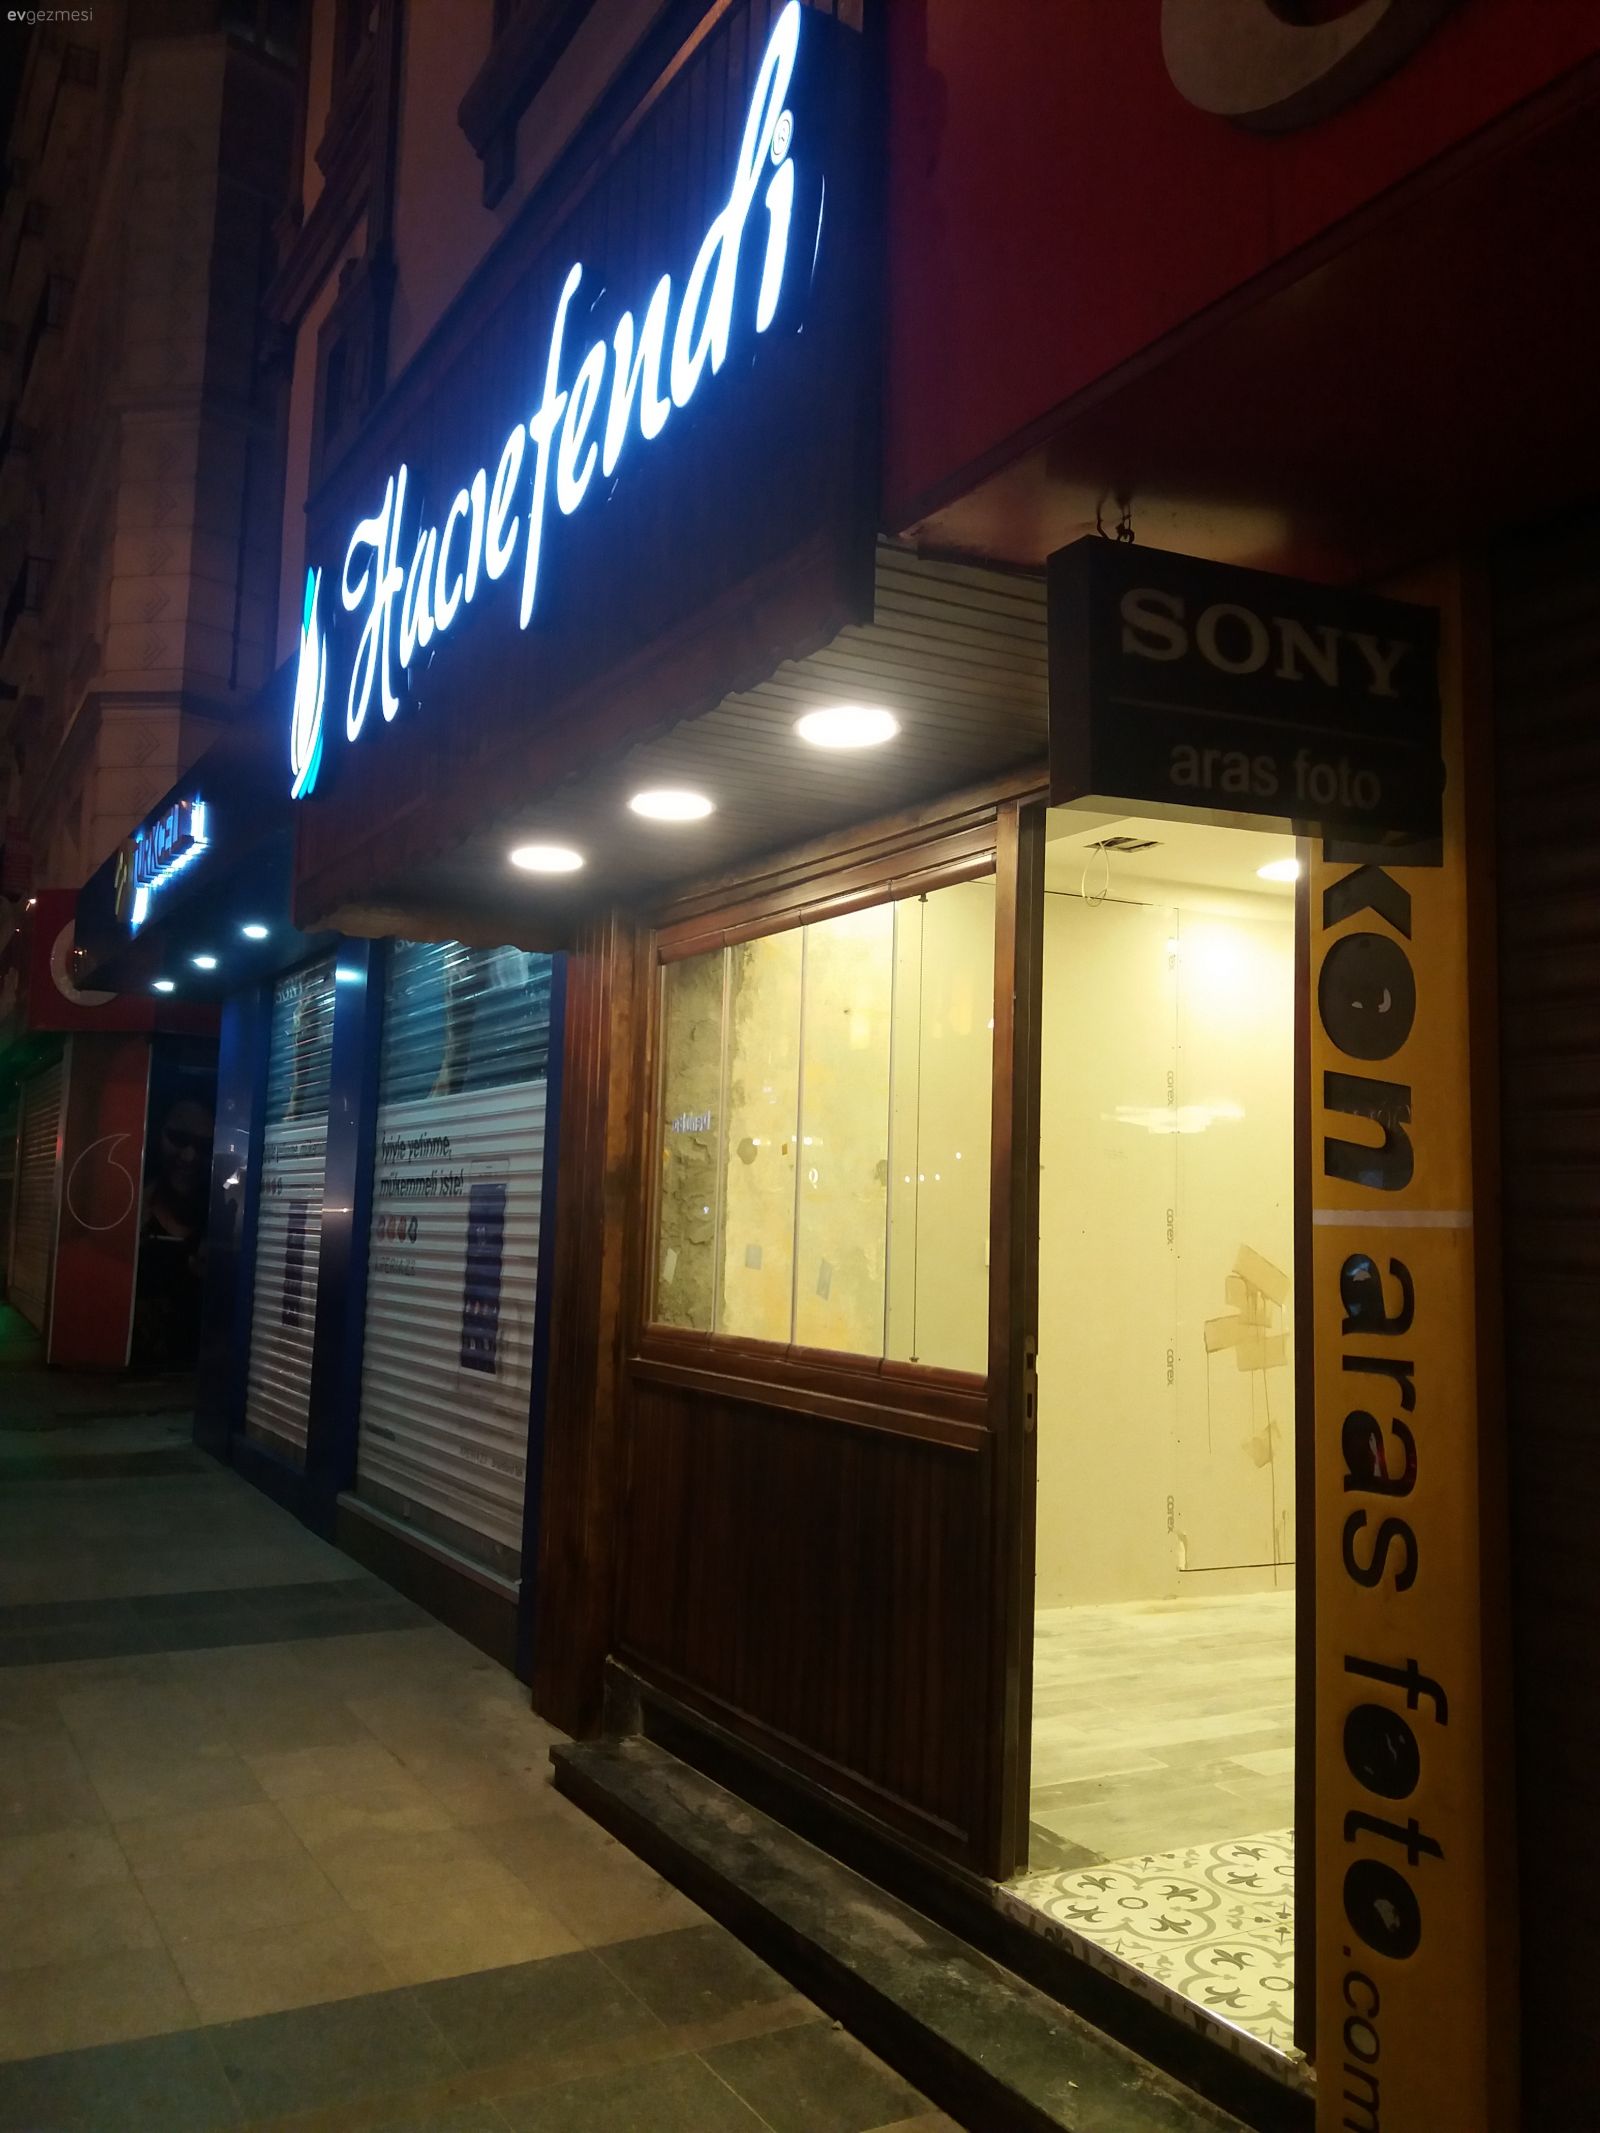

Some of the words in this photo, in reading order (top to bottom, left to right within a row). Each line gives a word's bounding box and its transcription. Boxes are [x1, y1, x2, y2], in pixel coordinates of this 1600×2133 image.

[1120, 587, 1412, 699] SONY
[1168, 744, 1279, 798] aras
[1295, 748, 1382, 811] foto
[1166, 1070, 1176, 1107] corex
[1166, 1208, 1175, 1245] corex
[1166, 1348, 1175, 1386] corex
[1340, 1253, 1418, 1593] aras
[1166, 1495, 1175, 1534] corex
